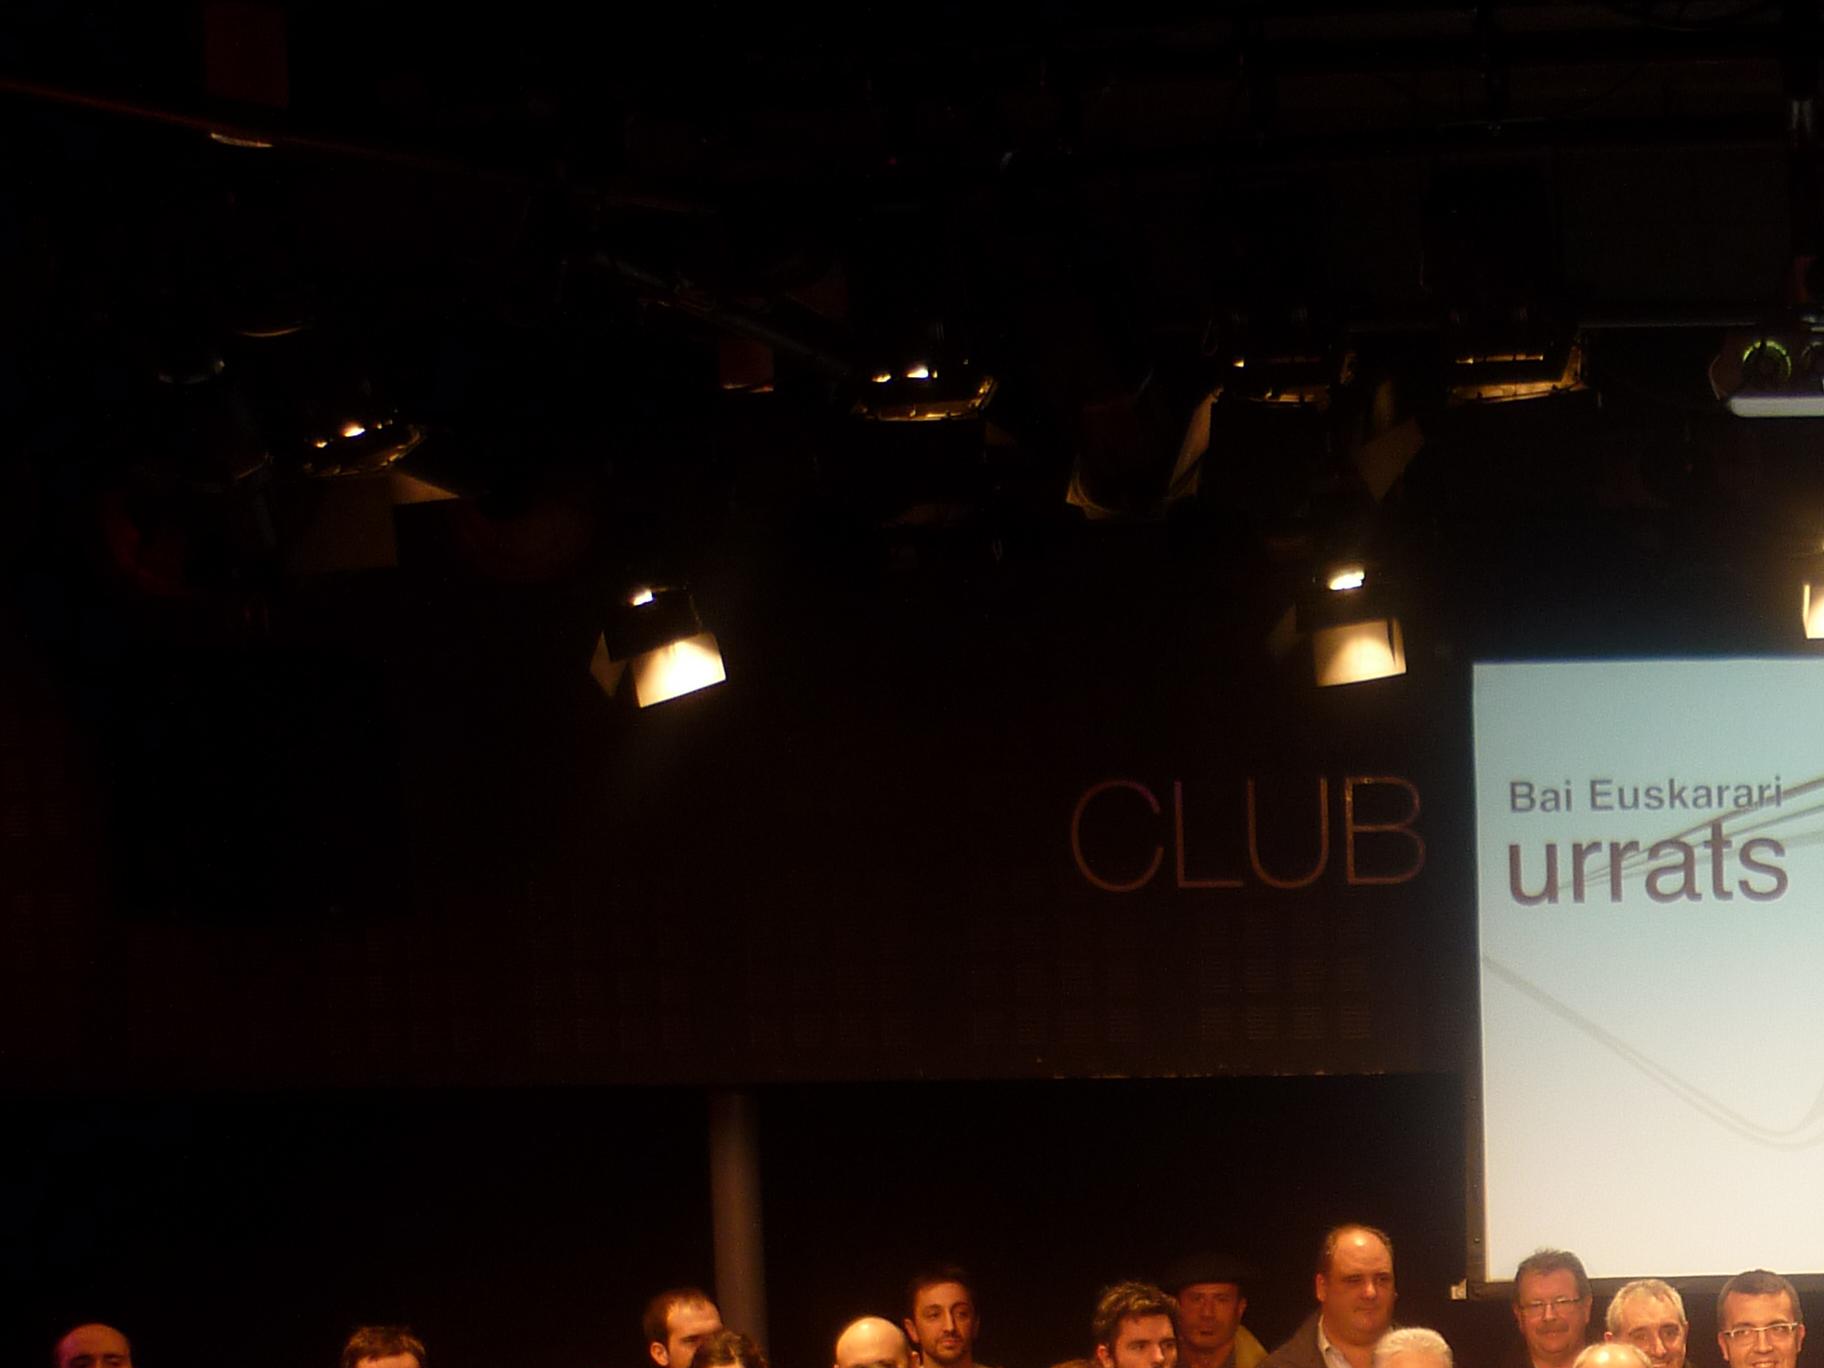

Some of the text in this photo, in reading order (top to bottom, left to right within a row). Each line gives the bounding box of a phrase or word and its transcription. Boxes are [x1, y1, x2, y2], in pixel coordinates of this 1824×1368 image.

[1071, 777, 1425, 893] CLUB
[1509, 775, 1783, 813] Bai Euskarari
[1508, 821, 1789, 906] urrats
